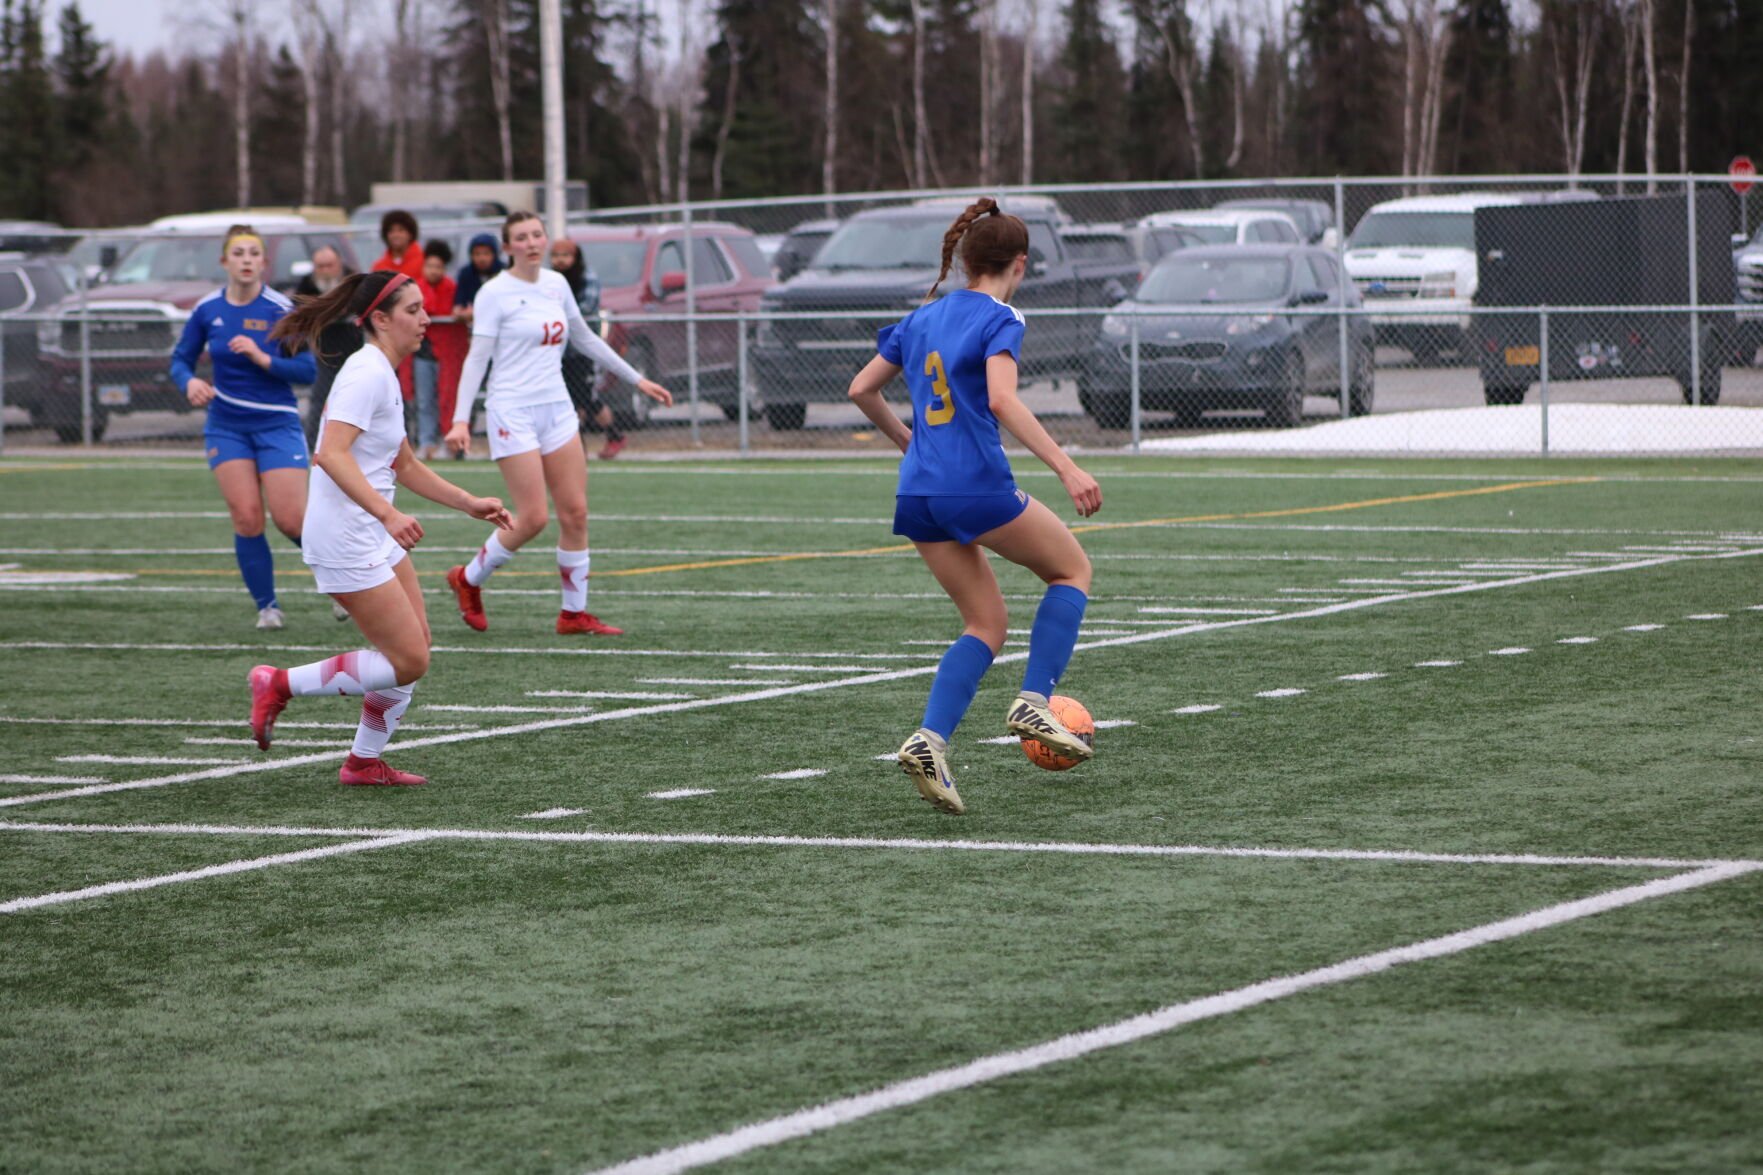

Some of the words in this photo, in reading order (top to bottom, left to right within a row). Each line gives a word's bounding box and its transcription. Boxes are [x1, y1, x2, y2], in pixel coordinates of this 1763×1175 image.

[540, 321, 564, 346] 12
[924, 350, 956, 426] 3
[1008, 702, 1059, 735] NIKE
[904, 740, 938, 781] NIKE
